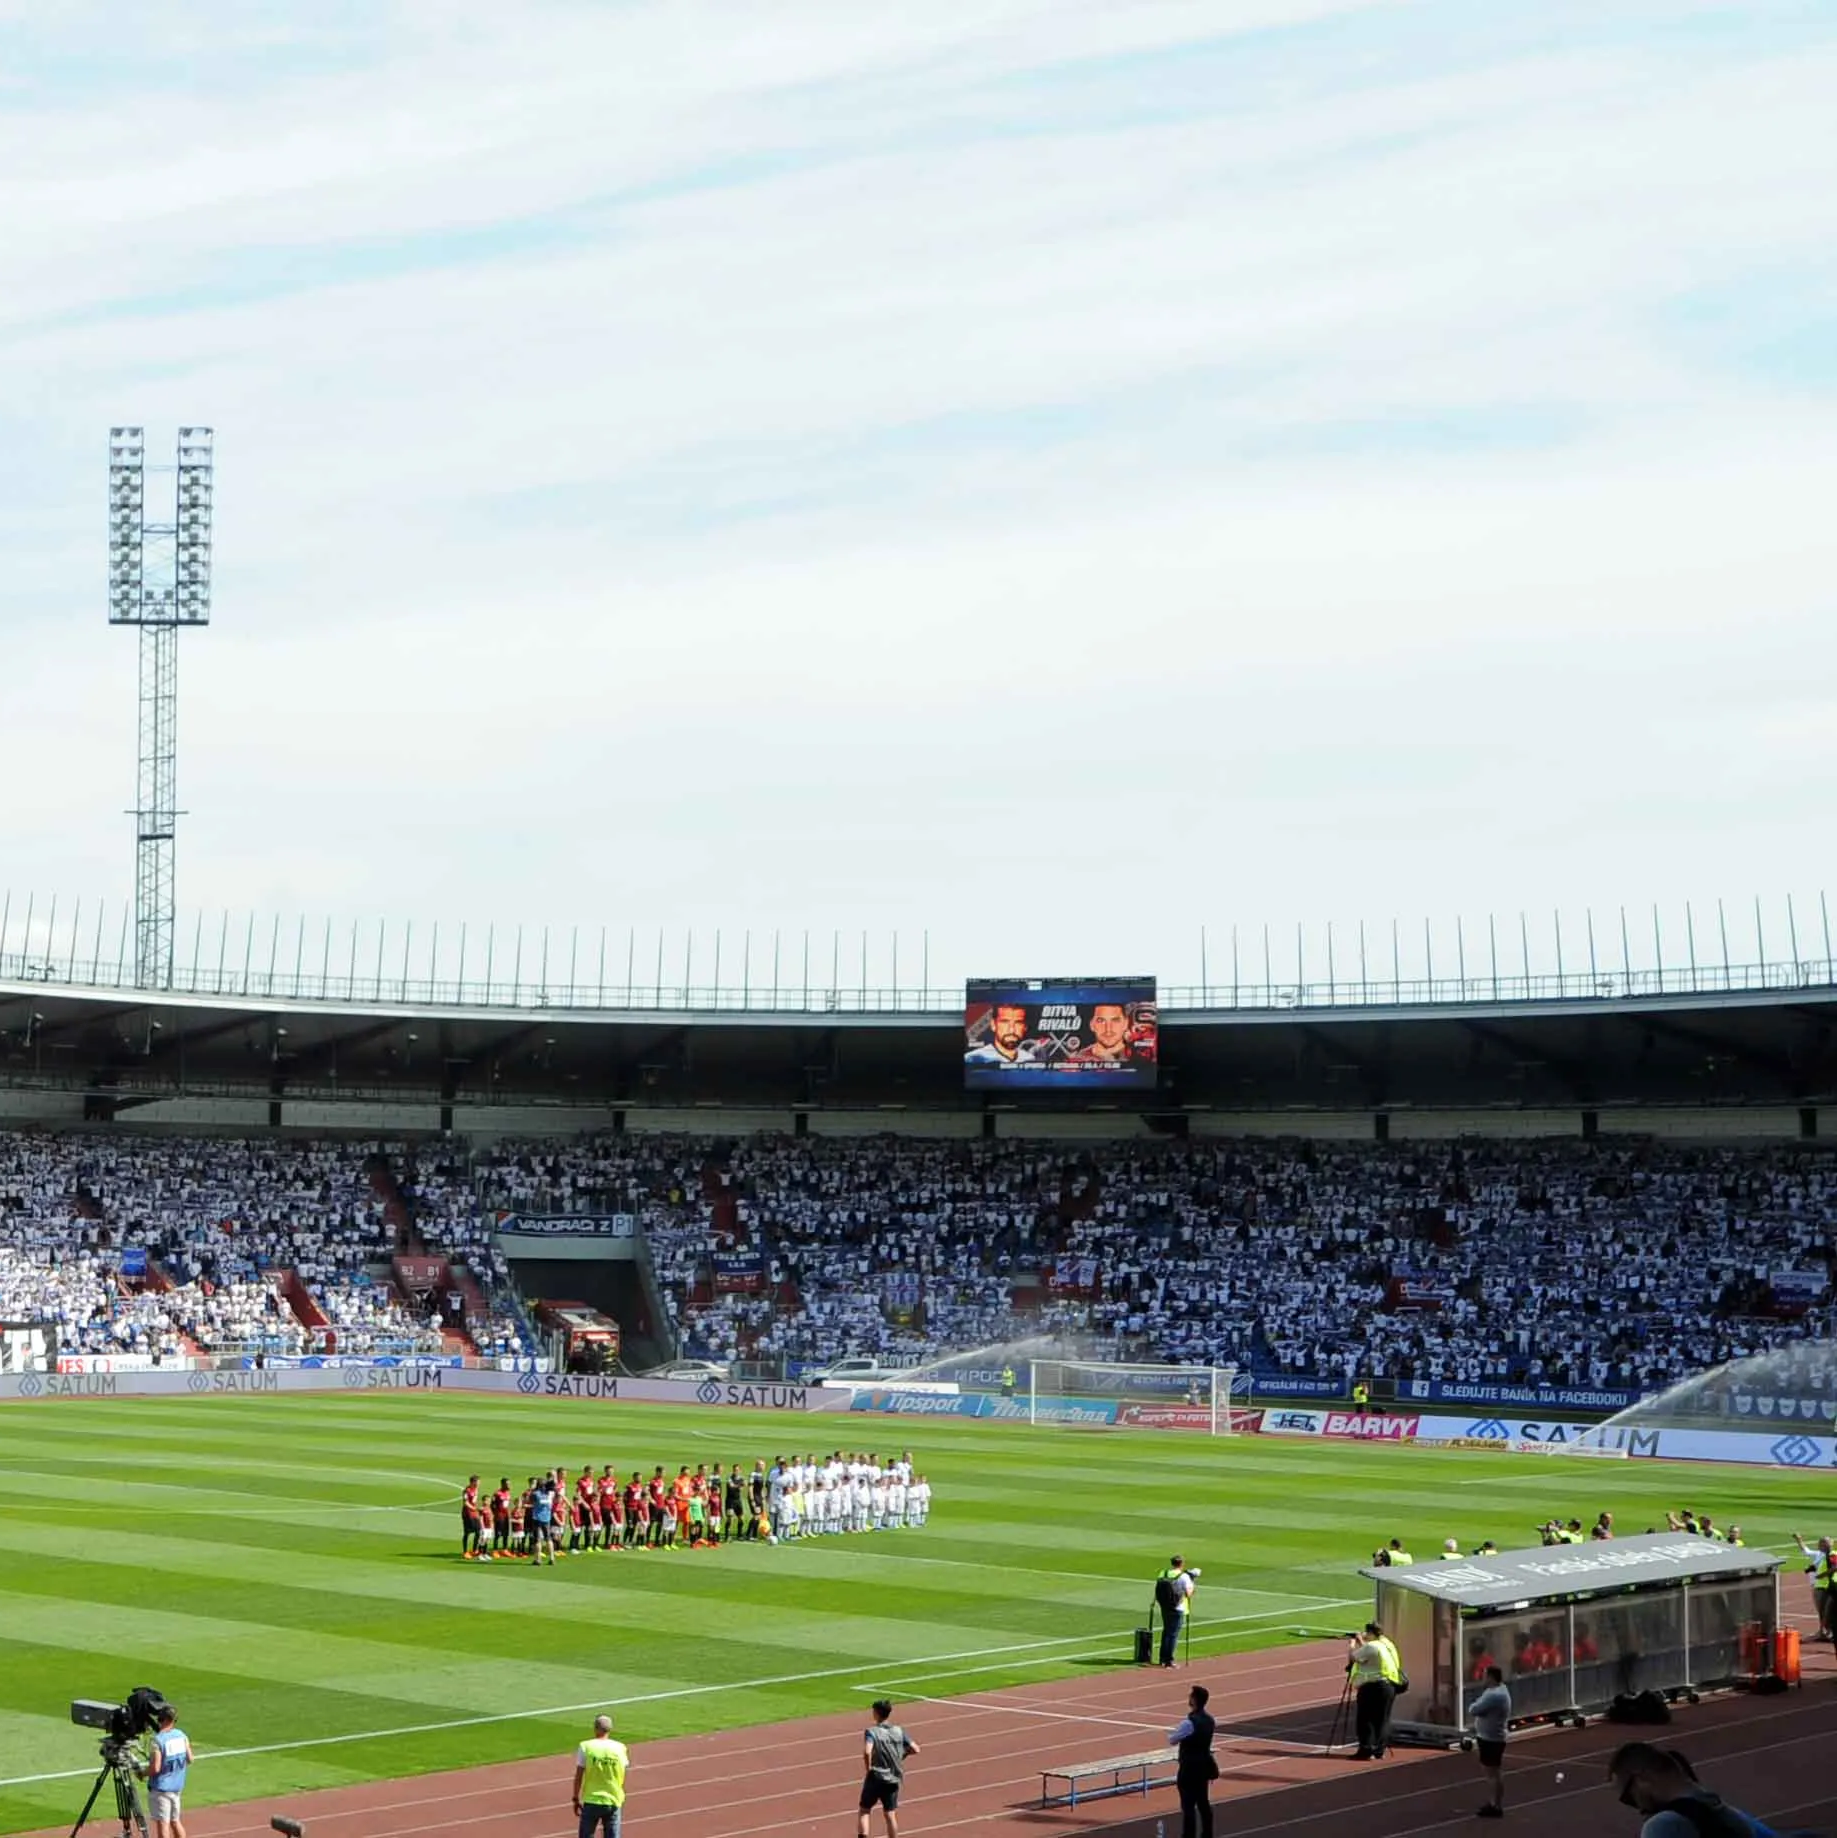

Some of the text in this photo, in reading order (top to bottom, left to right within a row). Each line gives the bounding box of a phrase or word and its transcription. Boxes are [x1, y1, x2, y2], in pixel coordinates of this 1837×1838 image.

[1041, 1005, 1077, 1017] BITVA
[46, 1376, 116, 1396] SATUM
[213, 1371, 278, 1391] SATUM
[366, 1369, 442, 1388] SATUM
[545, 1376, 618, 1398] SATUM
[727, 1385, 807, 1409] SATUM
[889, 1393, 962, 1413] Tipsport
[1442, 1385, 1498, 1400] SLEDUJTE
[1501, 1386, 1535, 1401] BANÍK
[1539, 1389, 1556, 1402] NA
[1561, 1391, 1627, 1405] FACEBOOKU
[1328, 1416, 1417, 1436] BARVY
